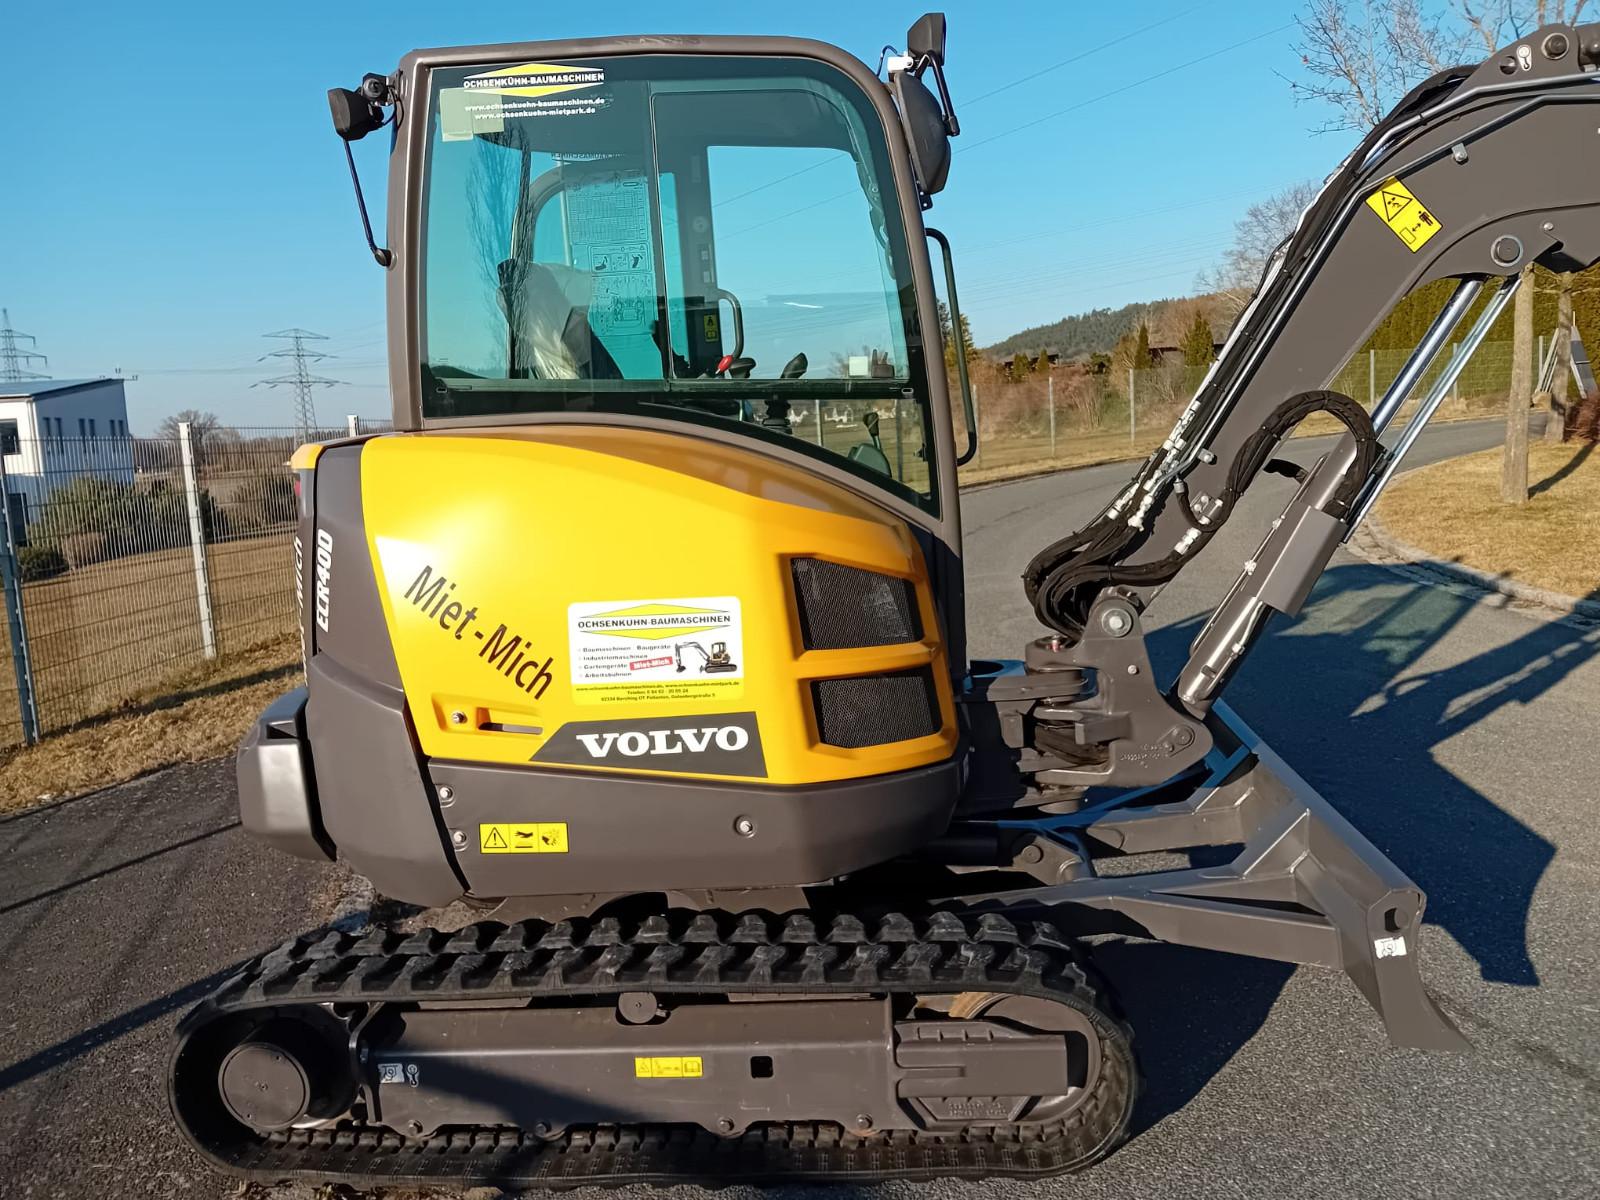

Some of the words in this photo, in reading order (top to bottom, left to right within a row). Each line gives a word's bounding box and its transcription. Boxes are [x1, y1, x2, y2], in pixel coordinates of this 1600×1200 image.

[463, 72, 605, 89] OCHSENKÜHN-BAUMASCHINEN
[404, 565, 554, 700] Miet-Mich
[576, 726, 749, 758] VOLVO
